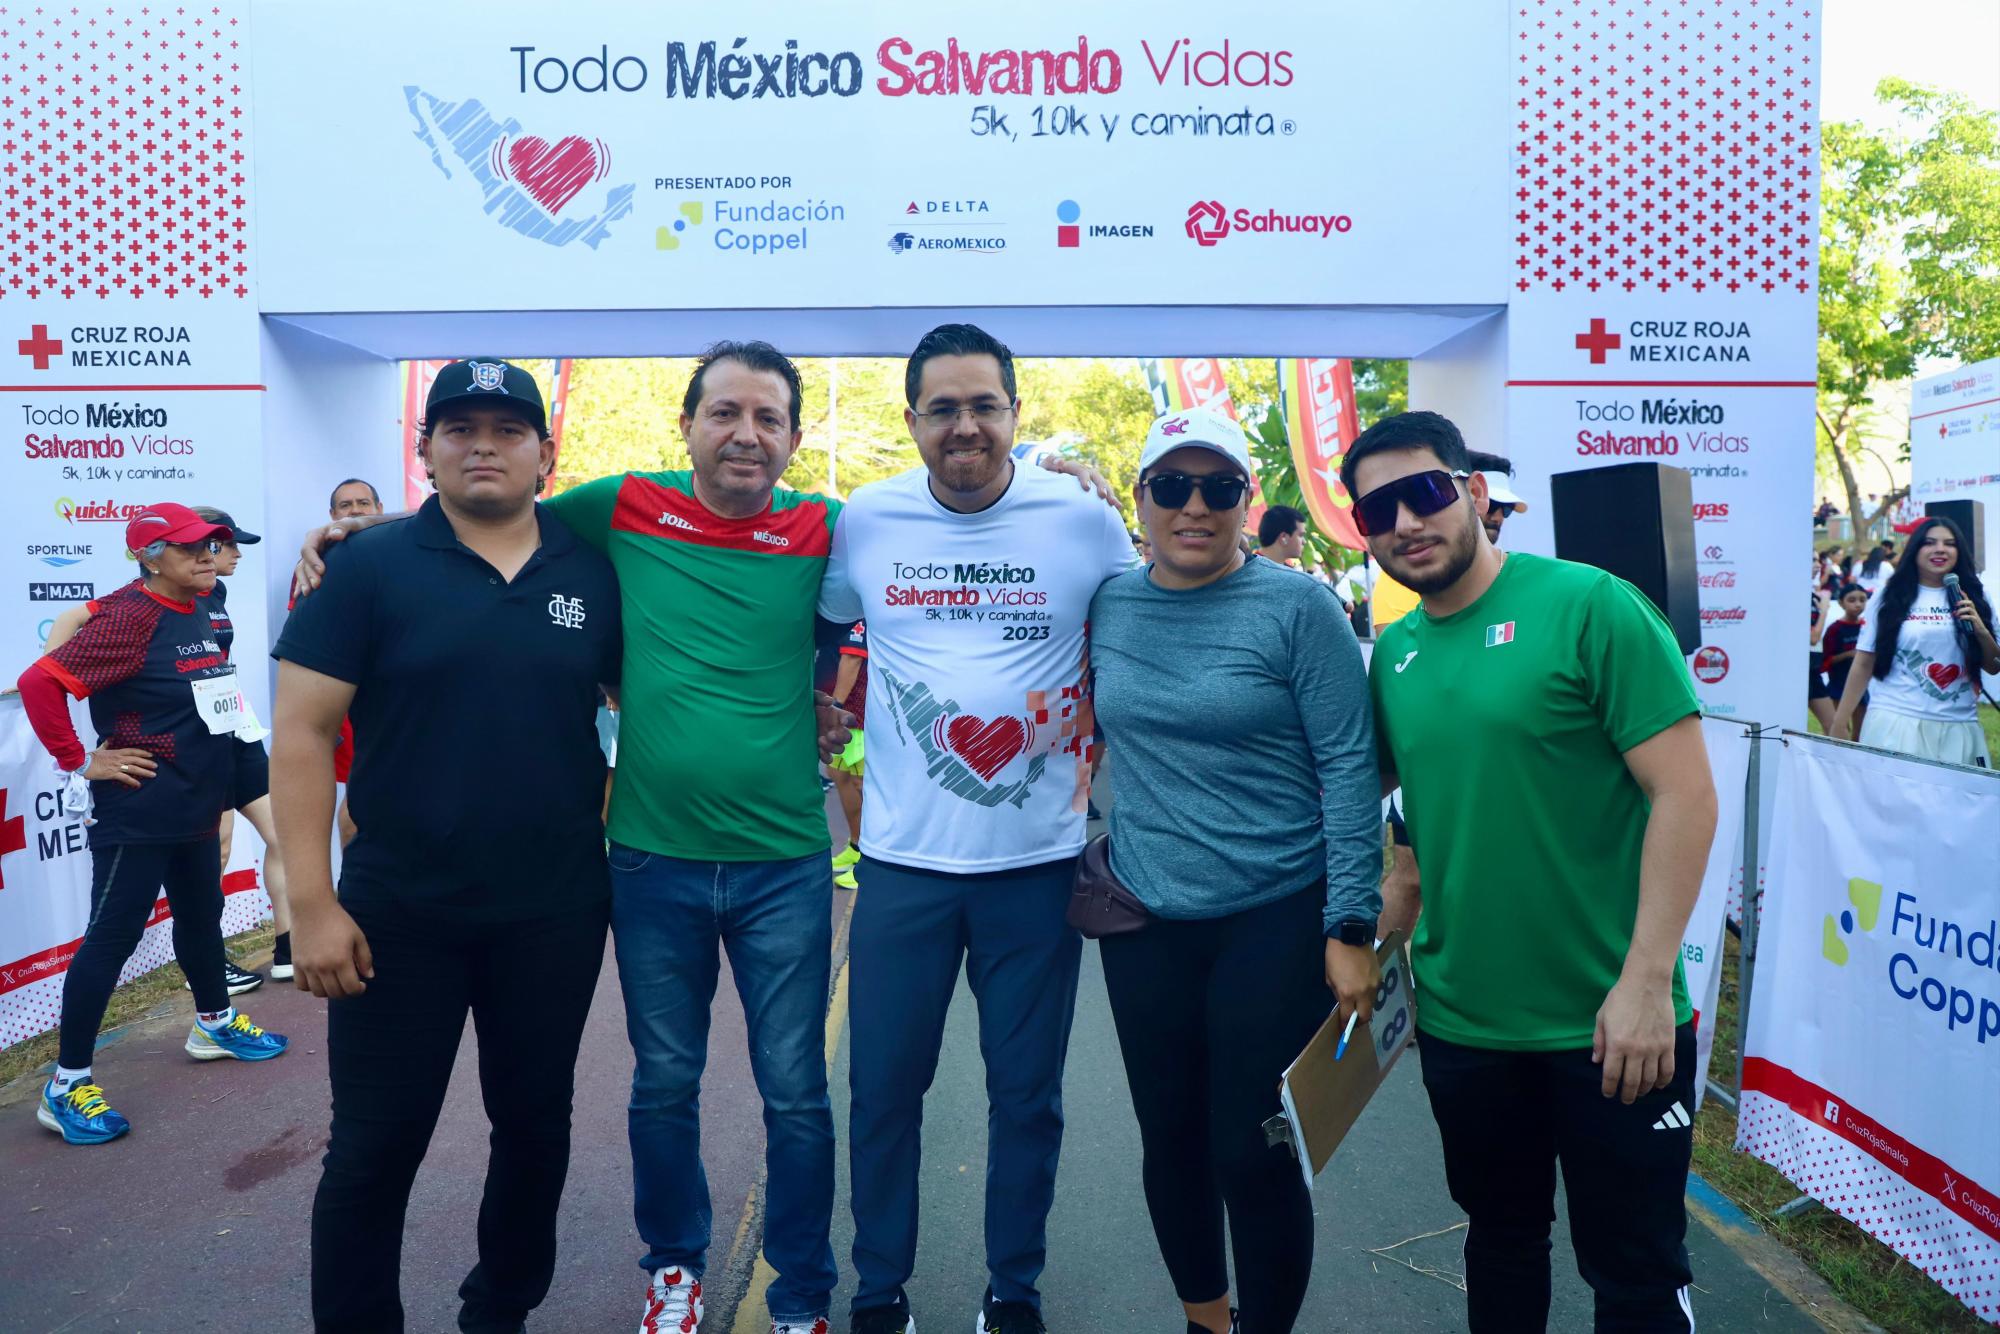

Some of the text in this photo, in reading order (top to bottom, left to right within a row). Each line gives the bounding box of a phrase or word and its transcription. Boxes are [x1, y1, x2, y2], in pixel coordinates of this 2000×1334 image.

[510, 35, 1294, 99] Todo México Salvando Vidas
[970, 105, 1018, 143] 5k,
[1030, 105, 1091, 137] 10k
[1100, 113, 1120, 142] y
[655, 176, 793, 190] PRESENTADO POR
[715, 199, 845, 222] Fundación
[926, 200, 990, 213] DELTA
[1089, 225, 1154, 238] IMAGEN
[1232, 208, 1352, 238] Sahuayo
[714, 227, 808, 255] Coppel
[71, 327, 191, 343] CRUZ ROJA
[1630, 321, 1751, 338] CRUZ ROJA
[72, 350, 192, 367] MEXICANA
[1630, 345, 1751, 362] MEXICANA
[22, 402, 167, 428] Todo México
[1576, 398, 1724, 425] Todo México
[24, 433, 194, 459] Salvando Vidas
[1576, 429, 1749, 456] Salvando Vidas
[62, 466, 82, 481] 5k,
[87, 466, 111, 480] 10k
[115, 469, 123, 481] y
[54, 497, 147, 525] Quick ga
[1692, 503, 1729, 520] gas
[753, 530, 789, 547] MÉXICO
[27, 545, 93, 555] SPORTLINE
[893, 562, 1035, 584] Todo México
[50, 585, 91, 599] MAJA
[885, 585, 1047, 606] Salvando Vidas
[925, 609, 945, 622] 5k,
[949, 608, 972, 620] 10k
[976, 612, 985, 622] y
[1002, 626, 1050, 641] 2023
[176, 643, 203, 656] Todo
[214, 697, 238, 714] 0015
[1846, 1117, 1909, 1167] CruzRojaSinaloa
